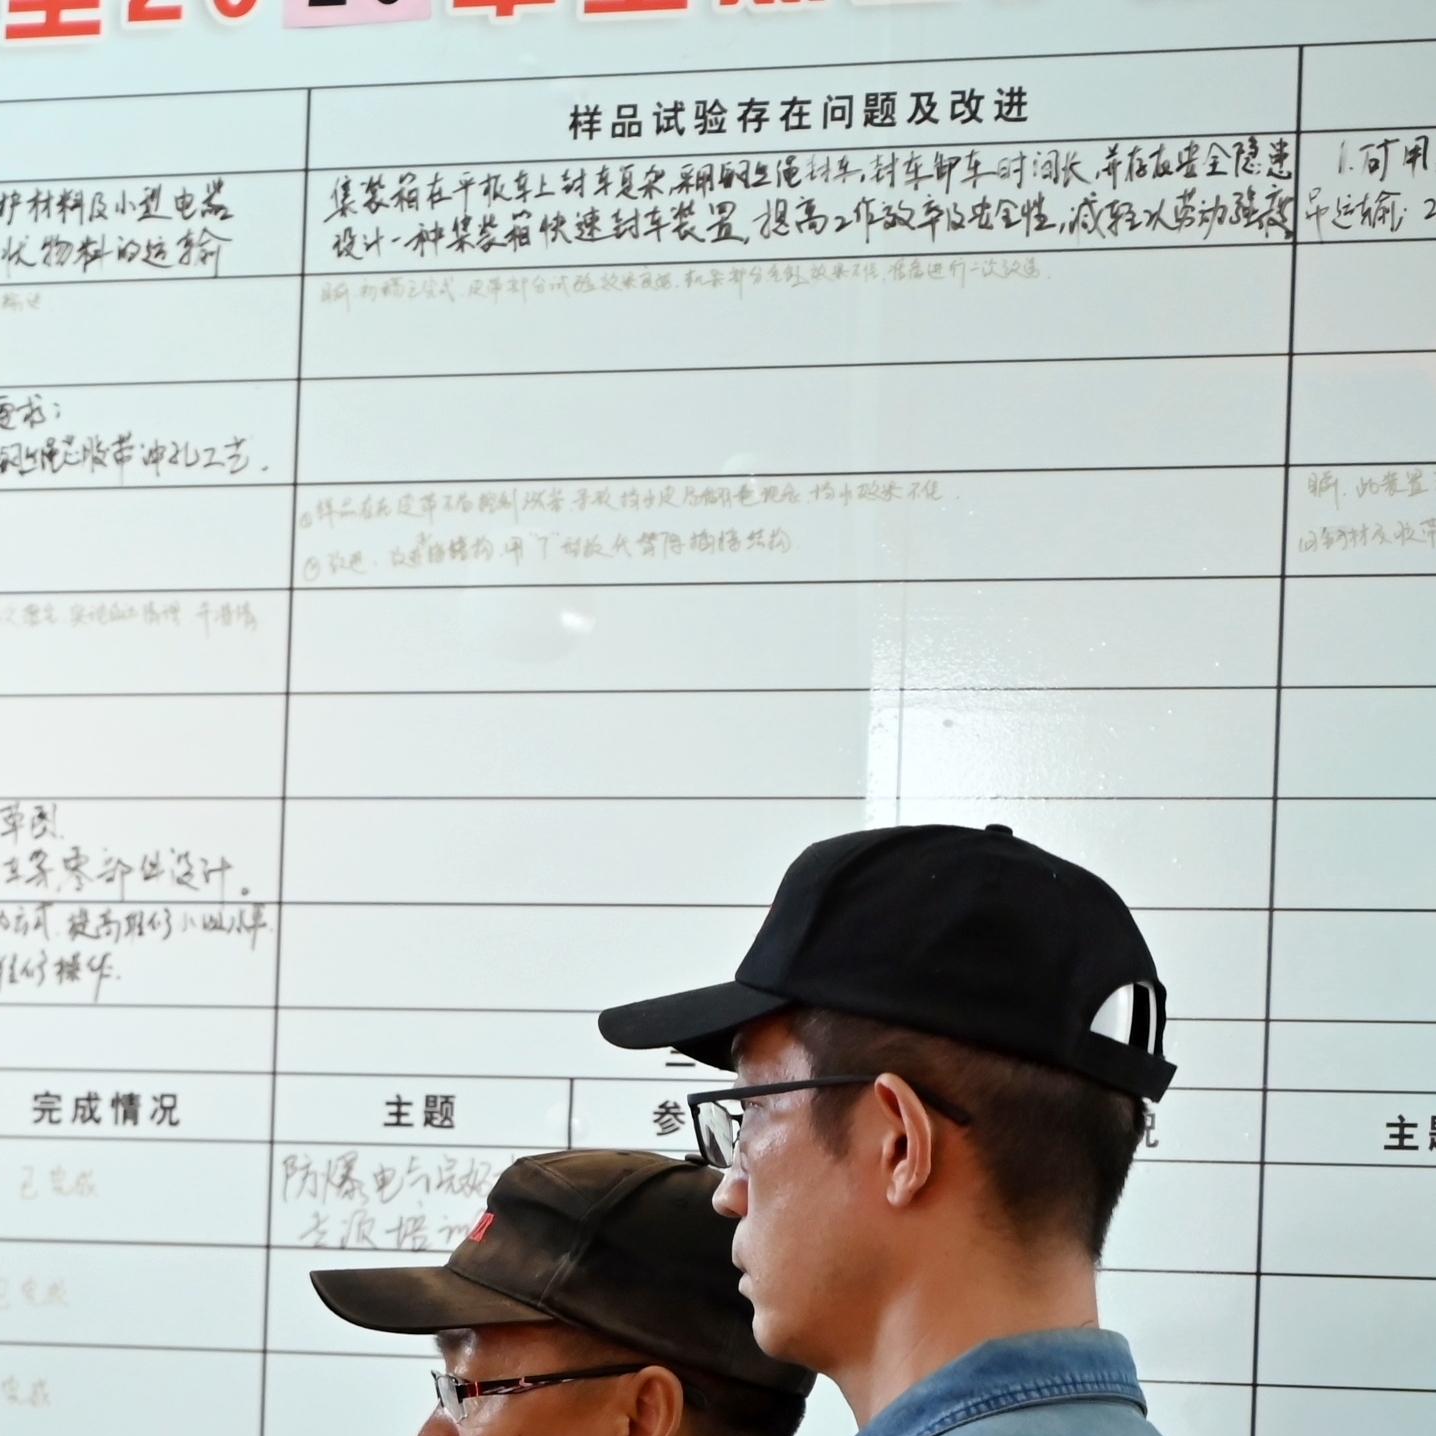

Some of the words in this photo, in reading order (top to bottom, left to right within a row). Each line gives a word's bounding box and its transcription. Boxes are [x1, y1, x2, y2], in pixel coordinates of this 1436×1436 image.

[569, 87, 1029, 139] 样品试验存在问题及改进
[32, 1091, 181, 1127] 完成情况
[383, 1094, 456, 1130] 主题
[1384, 1114, 1436, 1154] 主
